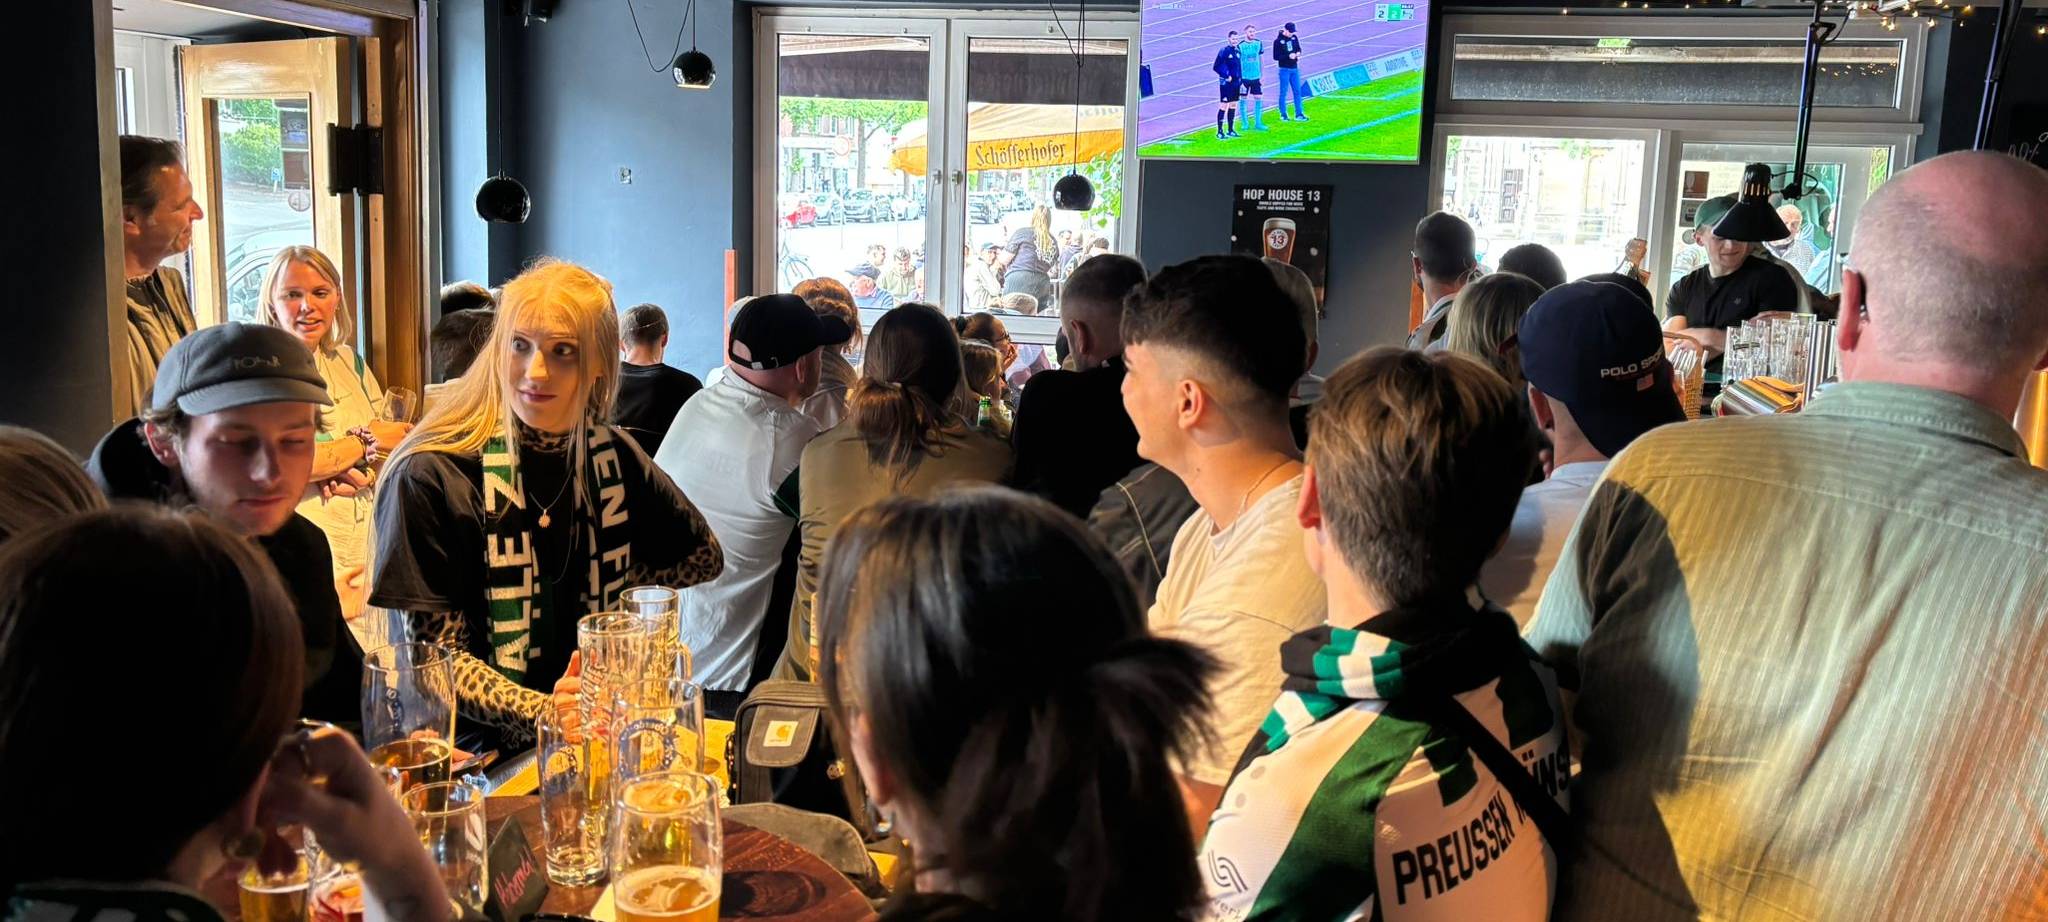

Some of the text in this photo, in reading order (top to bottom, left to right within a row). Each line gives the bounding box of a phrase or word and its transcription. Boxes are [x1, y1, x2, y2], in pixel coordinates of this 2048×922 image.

[975, 139, 1067, 167] Schöfferhofer
[1243, 188, 1321, 202] HOP HOUSE 13
[1600, 363, 1639, 379] POLO
[487, 530, 533, 674] ALLE
[1392, 789, 1516, 906] PREUSSEN
